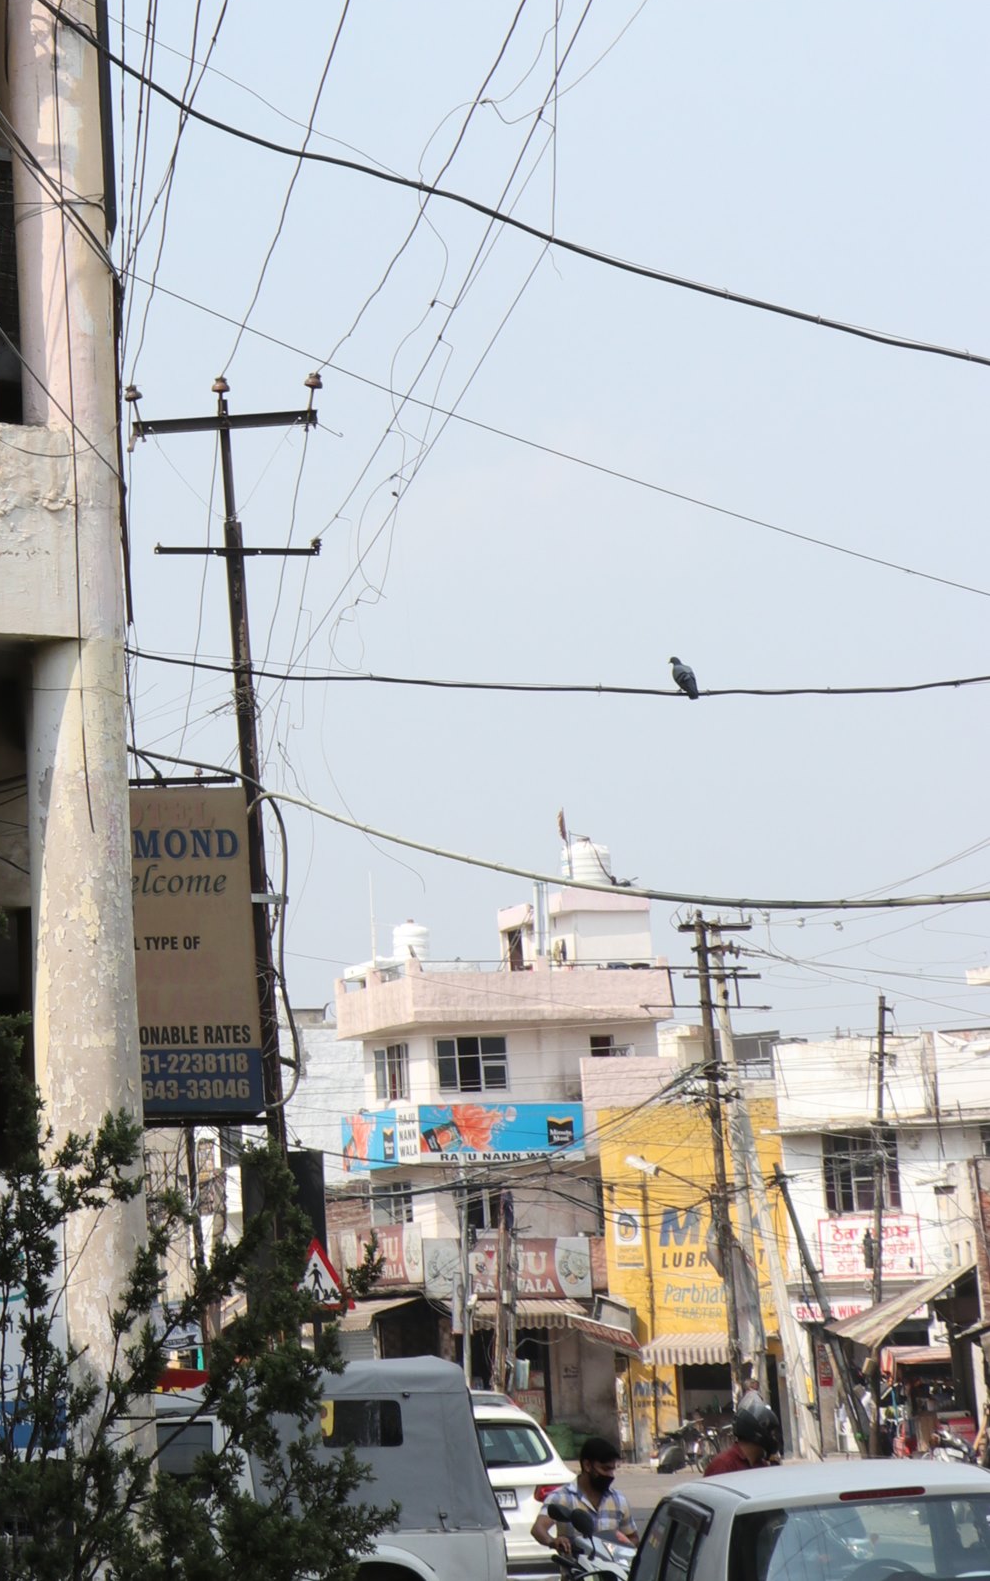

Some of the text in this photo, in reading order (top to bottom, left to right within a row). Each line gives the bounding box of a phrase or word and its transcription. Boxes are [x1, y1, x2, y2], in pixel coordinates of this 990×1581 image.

[144, 936, 178, 950] TYPE
[183, 936, 201, 949] OF
[204, 1024, 252, 1044] RATES
[400, 1146, 418, 1157] WALA
[440, 1153, 477, 1161] RAU
[482, 1152, 521, 1161] NANN
